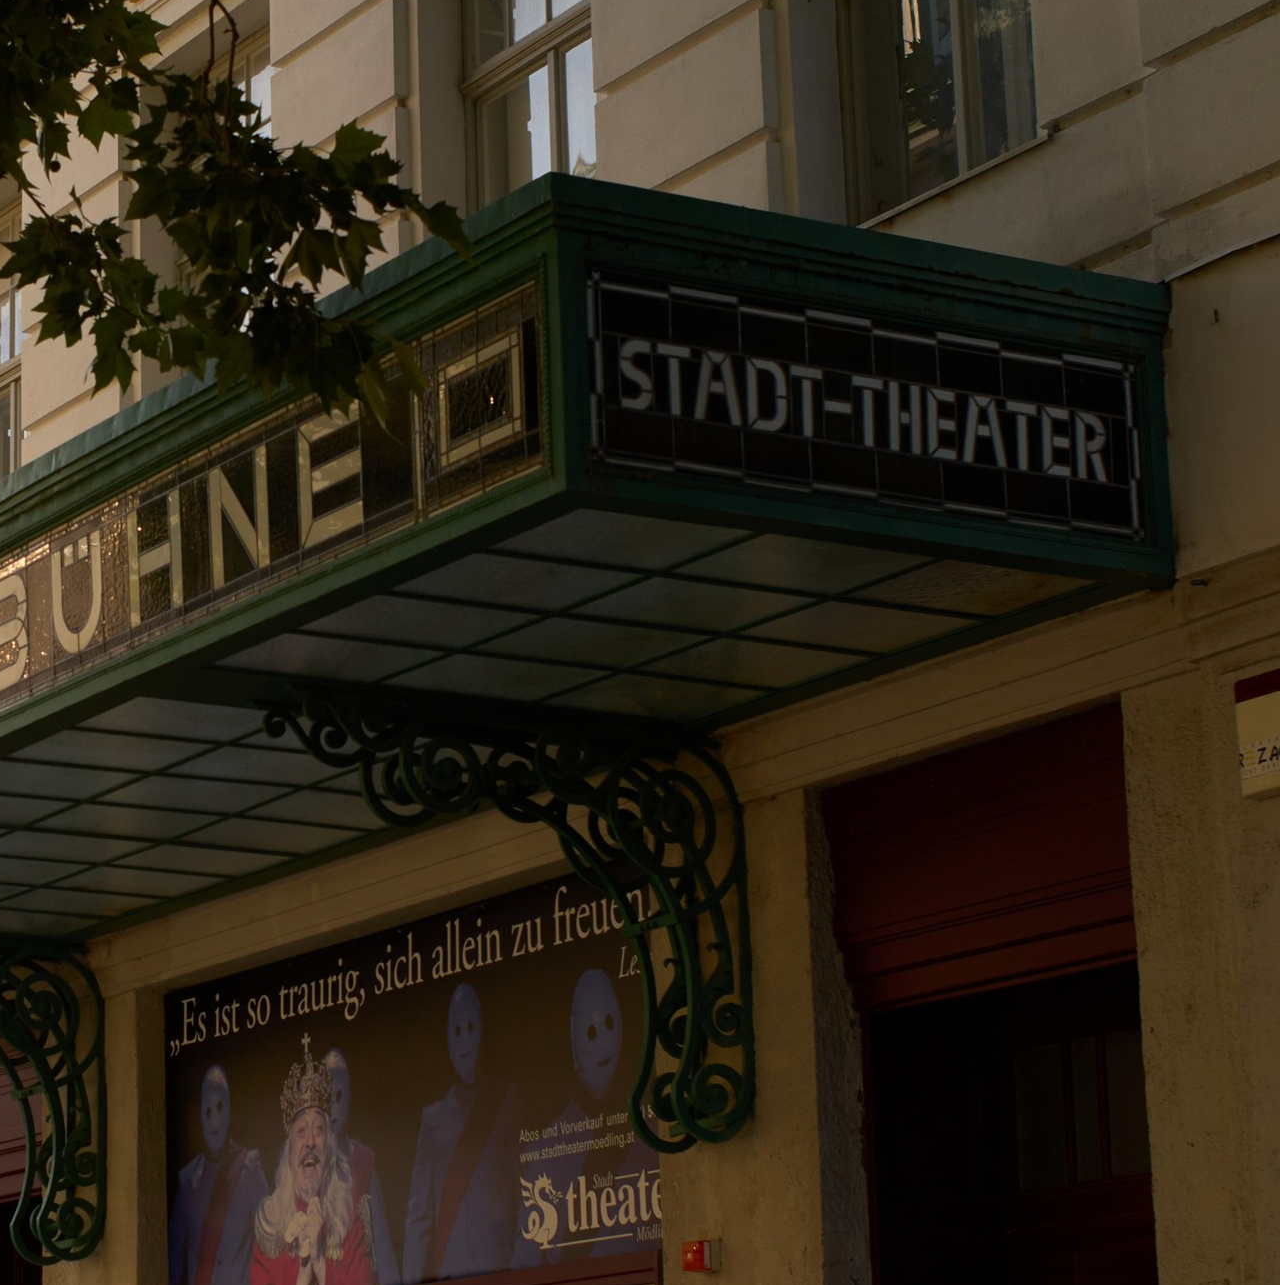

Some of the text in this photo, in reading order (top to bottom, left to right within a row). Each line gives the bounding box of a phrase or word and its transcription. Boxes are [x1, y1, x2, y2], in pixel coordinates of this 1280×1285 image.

[618, 337, 1108, 483] STADT-THEATER
[169, 997, 207, 1057] „Es
[213, 993, 240, 1038] ist
[246, 994, 271, 1029] so
[278, 957, 366, 1021] traurig,
[374, 931, 423, 995] sich
[431, 917, 503, 979] allein
[511, 915, 554, 957] zu
[518, 1129, 539, 1143] Abos
[542, 1122, 558, 1139] und
[559, 1113, 604, 1136] Vorverkauf
[606, 1111, 629, 1126] unter
[518, 1130, 635, 1163] www.stadttheatermoedling.at
[592, 1171, 614, 1189] Stadt
[635, 1223, 663, 1242] Mödli
